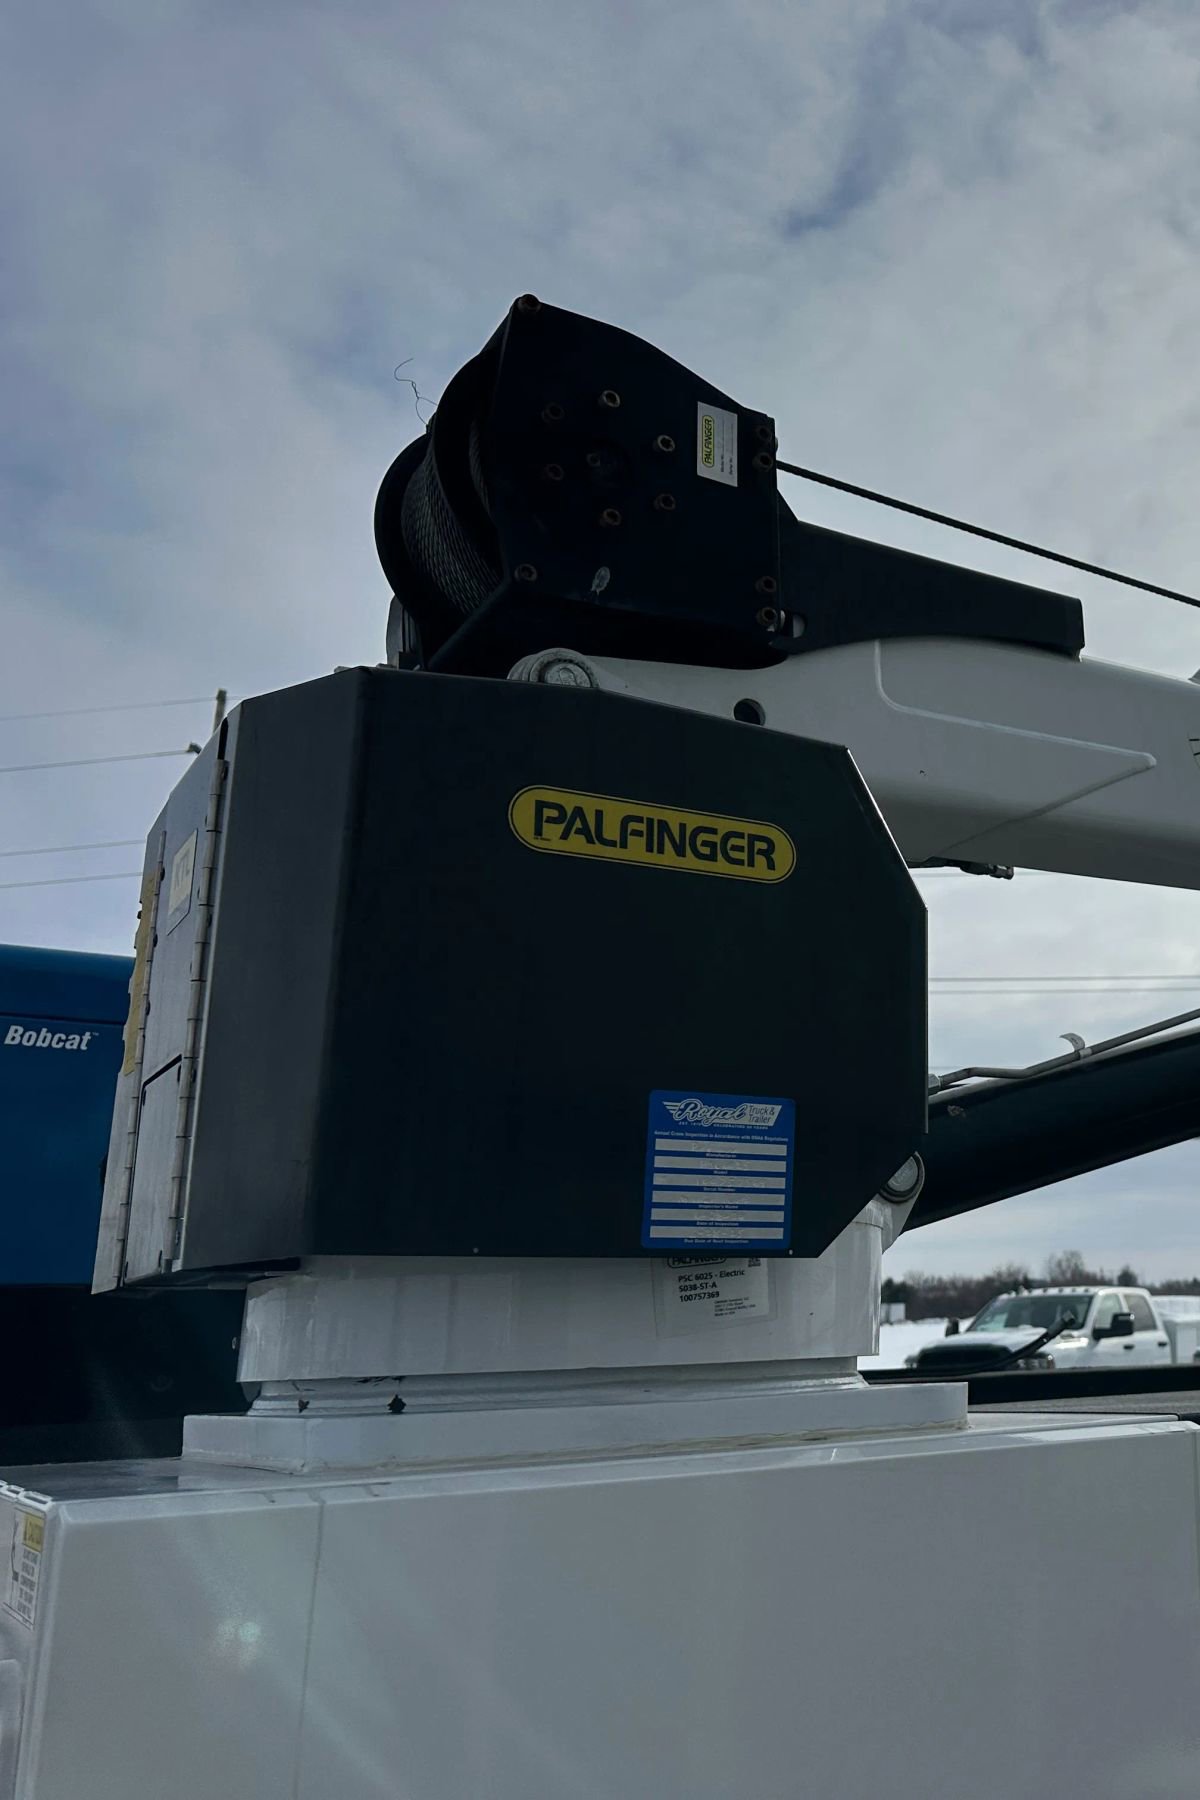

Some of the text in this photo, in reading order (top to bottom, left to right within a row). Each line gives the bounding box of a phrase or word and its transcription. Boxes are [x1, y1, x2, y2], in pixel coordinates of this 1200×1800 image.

[704, 418, 712, 464] PALFINGER
[533, 799, 776, 871] PALFINGER
[4, 1025, 91, 1050] Bobcat
[673, 1099, 749, 1126] Royal
[748, 1114, 771, 1123] Trailer
[750, 1105, 775, 1115] Truck &
[678, 1274, 693, 1283] PSC
[694, 1271, 713, 1281] 6025
[719, 1269, 745, 1278] Electric
